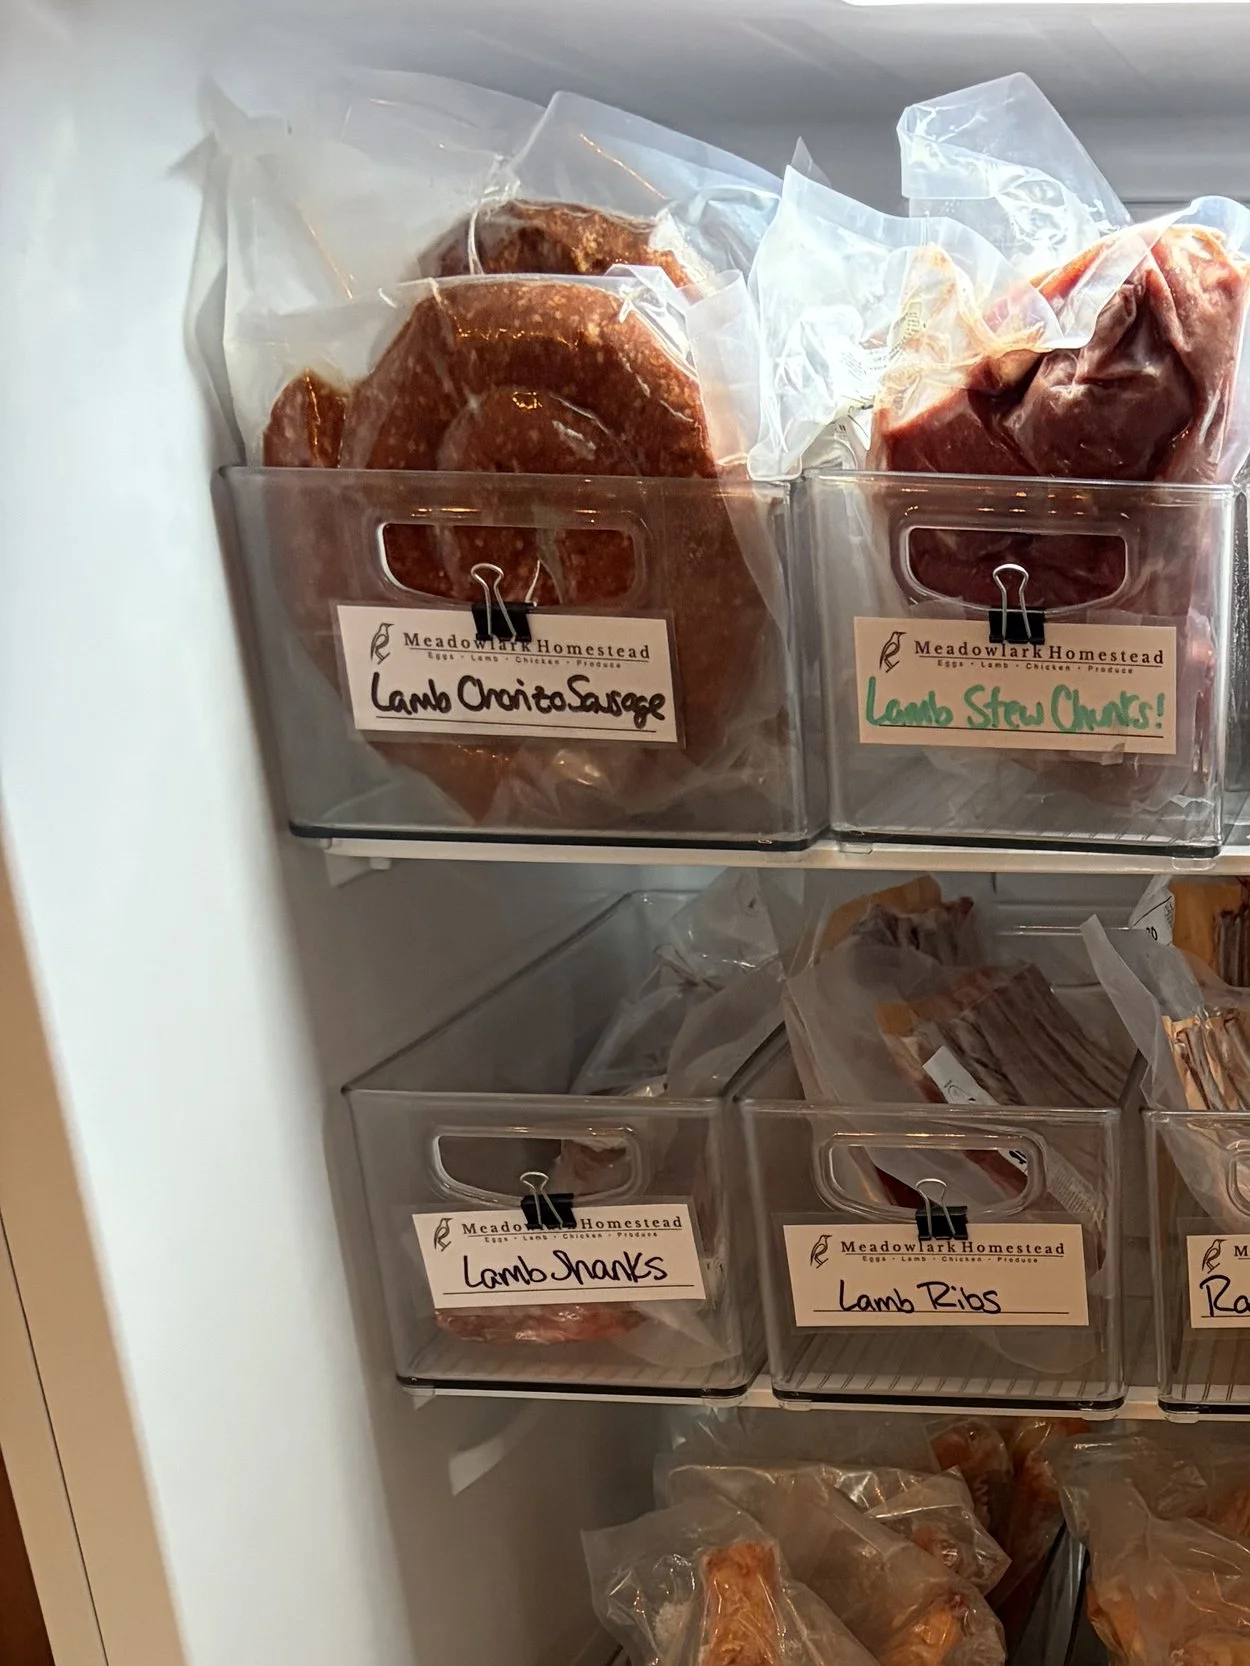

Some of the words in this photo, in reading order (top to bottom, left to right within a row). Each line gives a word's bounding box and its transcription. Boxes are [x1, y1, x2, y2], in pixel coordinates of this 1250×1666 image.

[403, 632, 532, 655] Meadowlark
[536, 638, 650, 661] Homestead
[914, 640, 1043, 660] Meadowlark
[1049, 645, 1165, 665] Homestead
[427, 651, 454, 661] Eggs
[471, 654, 499, 663] Lamb
[515, 656, 560, 666] Chicken
[576, 660, 622, 669] Produce
[937, 659, 964, 668] Eggs
[981, 661, 1010, 669] Lamb
[1026, 663, 1071, 672] Chicken
[1087, 665, 1134, 675] Produce
[370, 671, 451, 715] Lamb
[567, 674, 666, 729] Sausage
[865, 675, 954, 727] Lamb
[963, 684, 1045, 729] Stew
[461, 1221, 577, 1235] Meado
[580, 1215, 683, 1230] Homestead
[522, 1234, 548, 1242] Lamb
[841, 1240, 956, 1253] Meadowlark
[961, 1240, 1065, 1255] Homestead
[463, 1255, 547, 1289] Lamb
[550, 1250, 669, 1286] Shanks
[862, 1256, 887, 1264] Eggs
[901, 1255, 927, 1263] Lamb
[838, 1279, 915, 1314] Lamb
[916, 1280, 1002, 1315] Ribs
